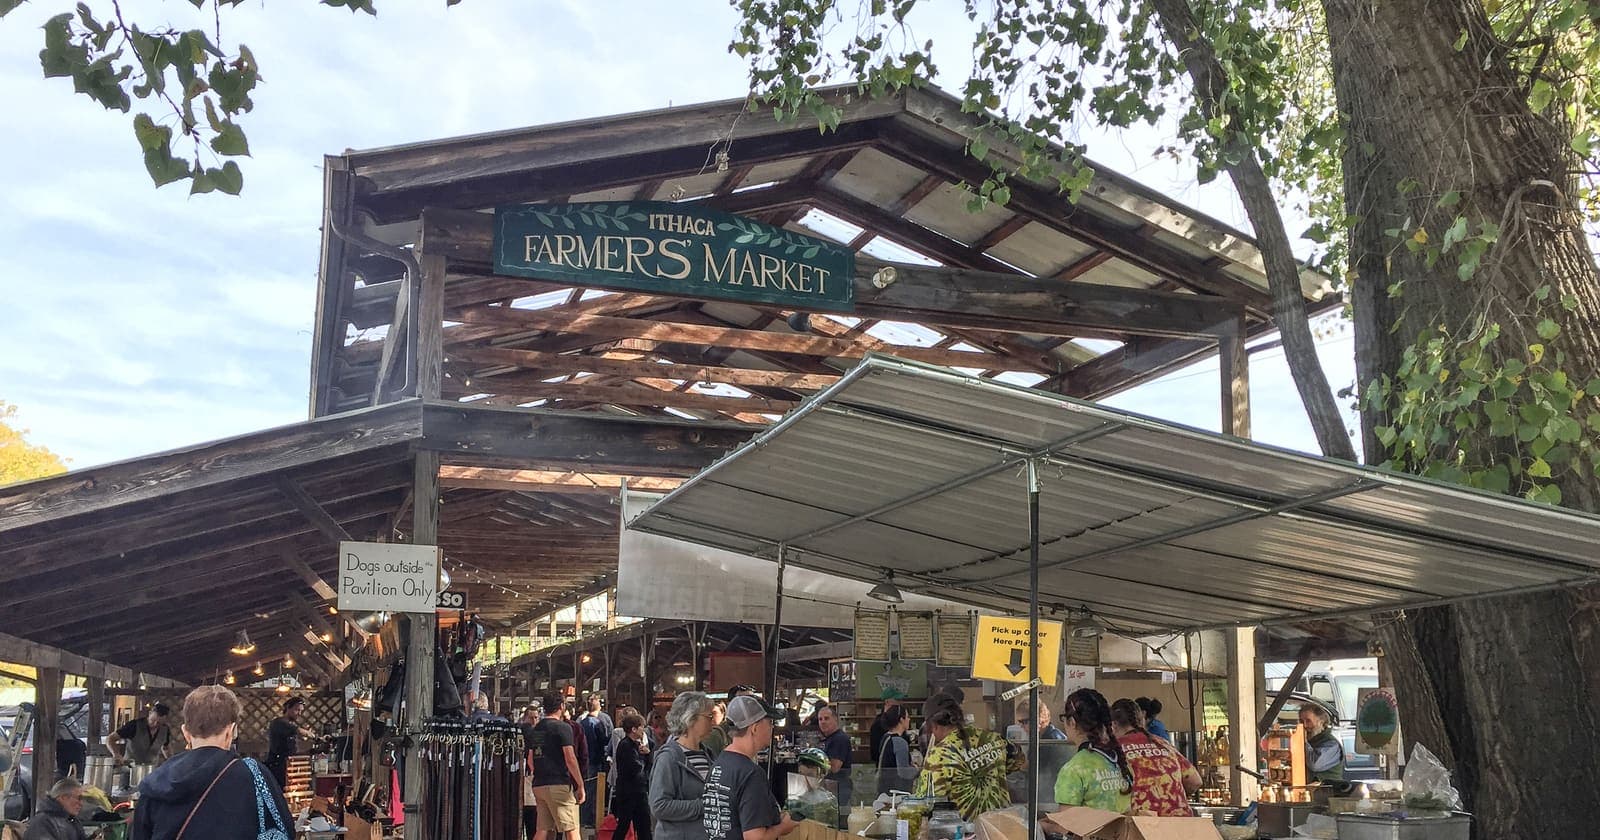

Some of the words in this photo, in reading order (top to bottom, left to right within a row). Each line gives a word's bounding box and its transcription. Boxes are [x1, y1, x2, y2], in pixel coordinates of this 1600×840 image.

[649, 214, 715, 237] ITHACA
[524, 234, 692, 280] FARMERS'
[703, 243, 830, 295] MARKET
[346, 553, 380, 576] Dogs
[384, 560, 424, 574] outside
[343, 577, 397, 596] Pavilion
[402, 578, 433, 605] Only
[991, 626, 1009, 634] Pick
[1024, 629, 1047, 638] Oer
[993, 637, 1012, 646] Here
